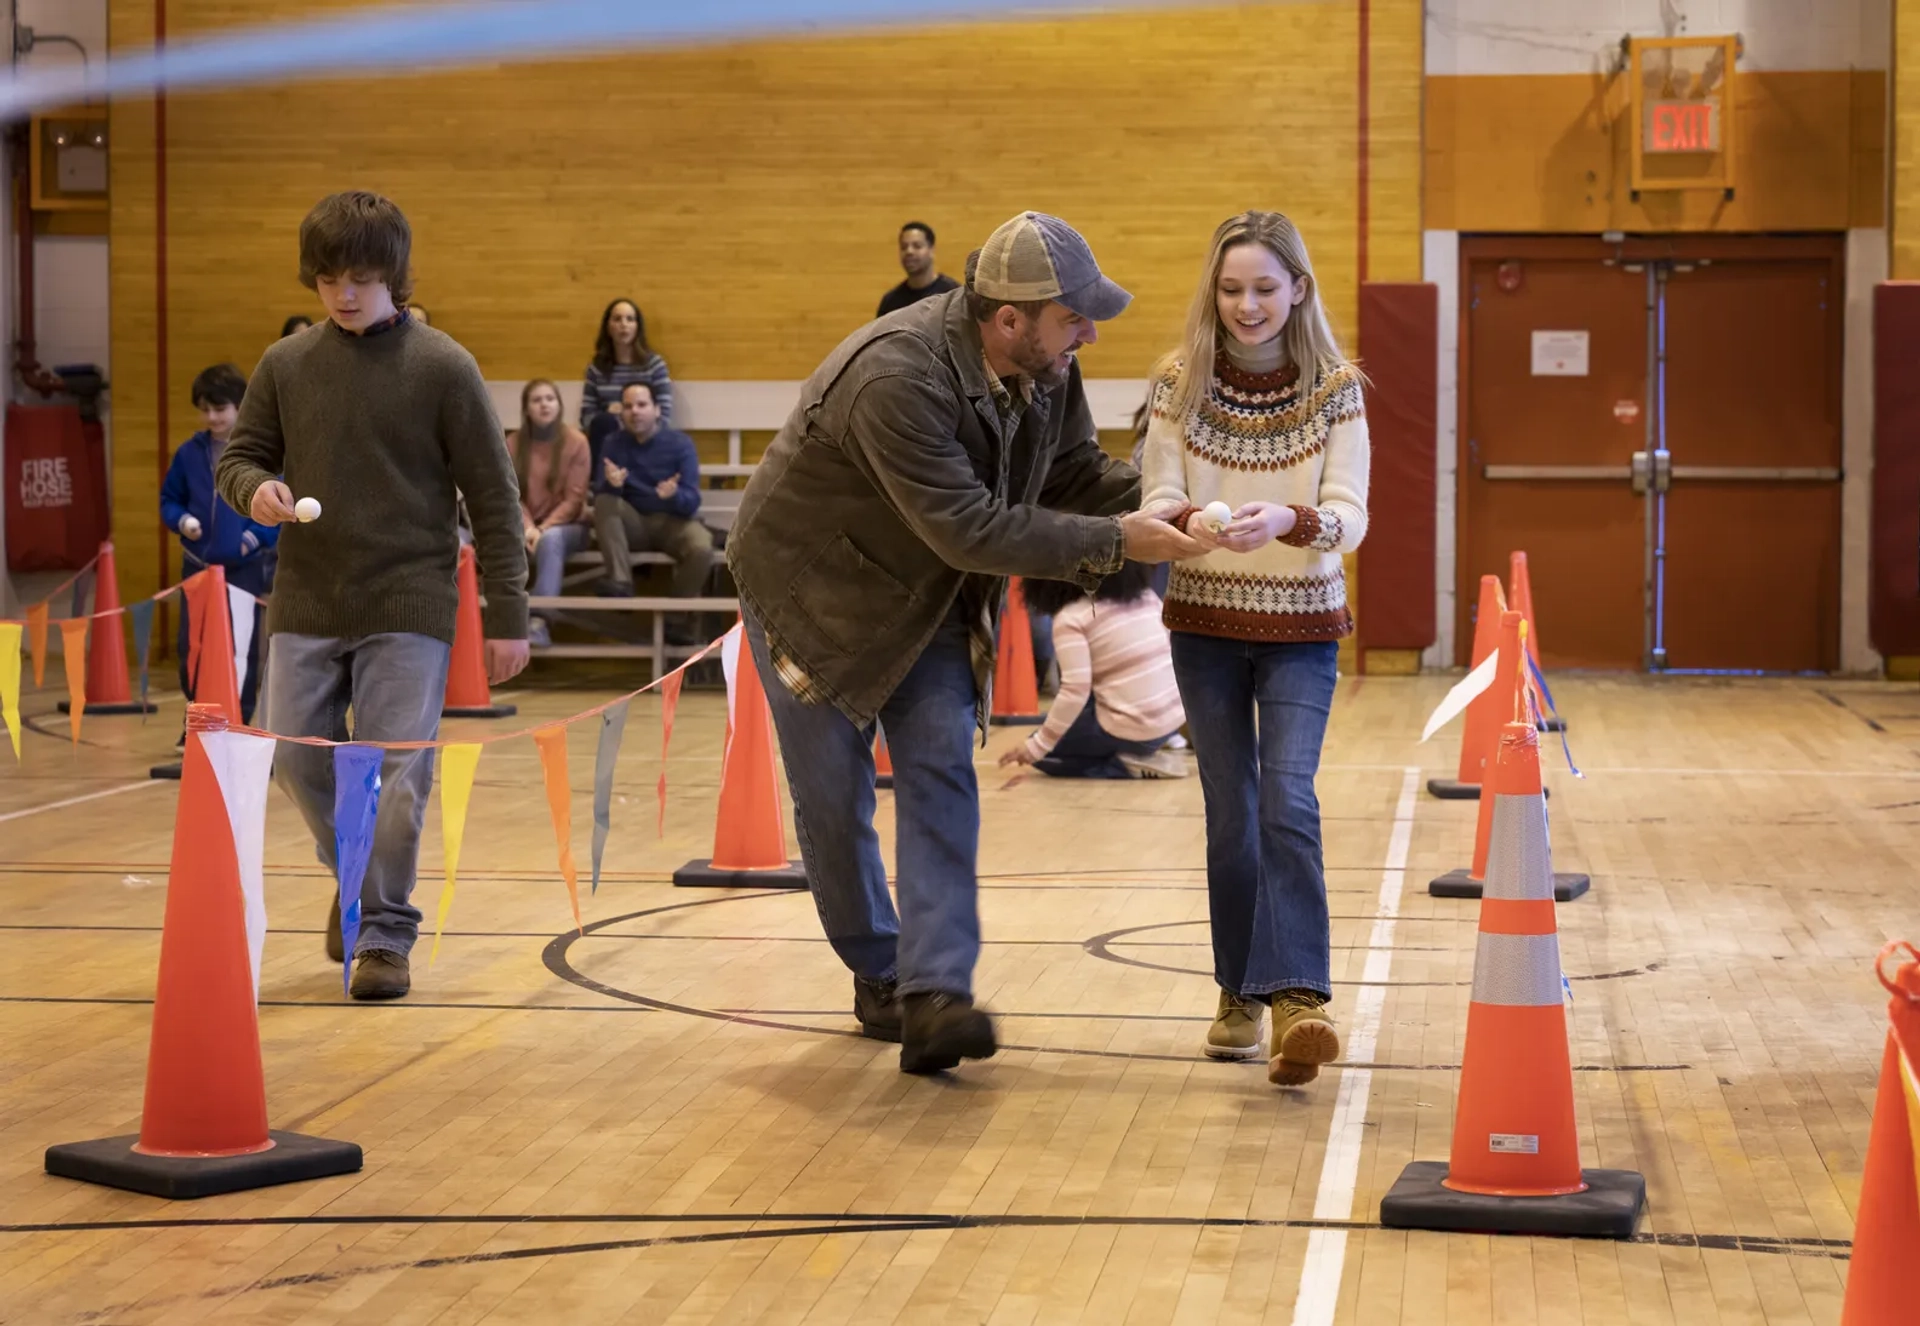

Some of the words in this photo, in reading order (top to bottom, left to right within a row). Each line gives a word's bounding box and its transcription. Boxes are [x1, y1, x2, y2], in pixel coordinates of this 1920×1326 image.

[1653, 104, 1712, 150] EXIT
[22, 457, 68, 481] FIRE
[20, 475, 72, 499] HOSE
